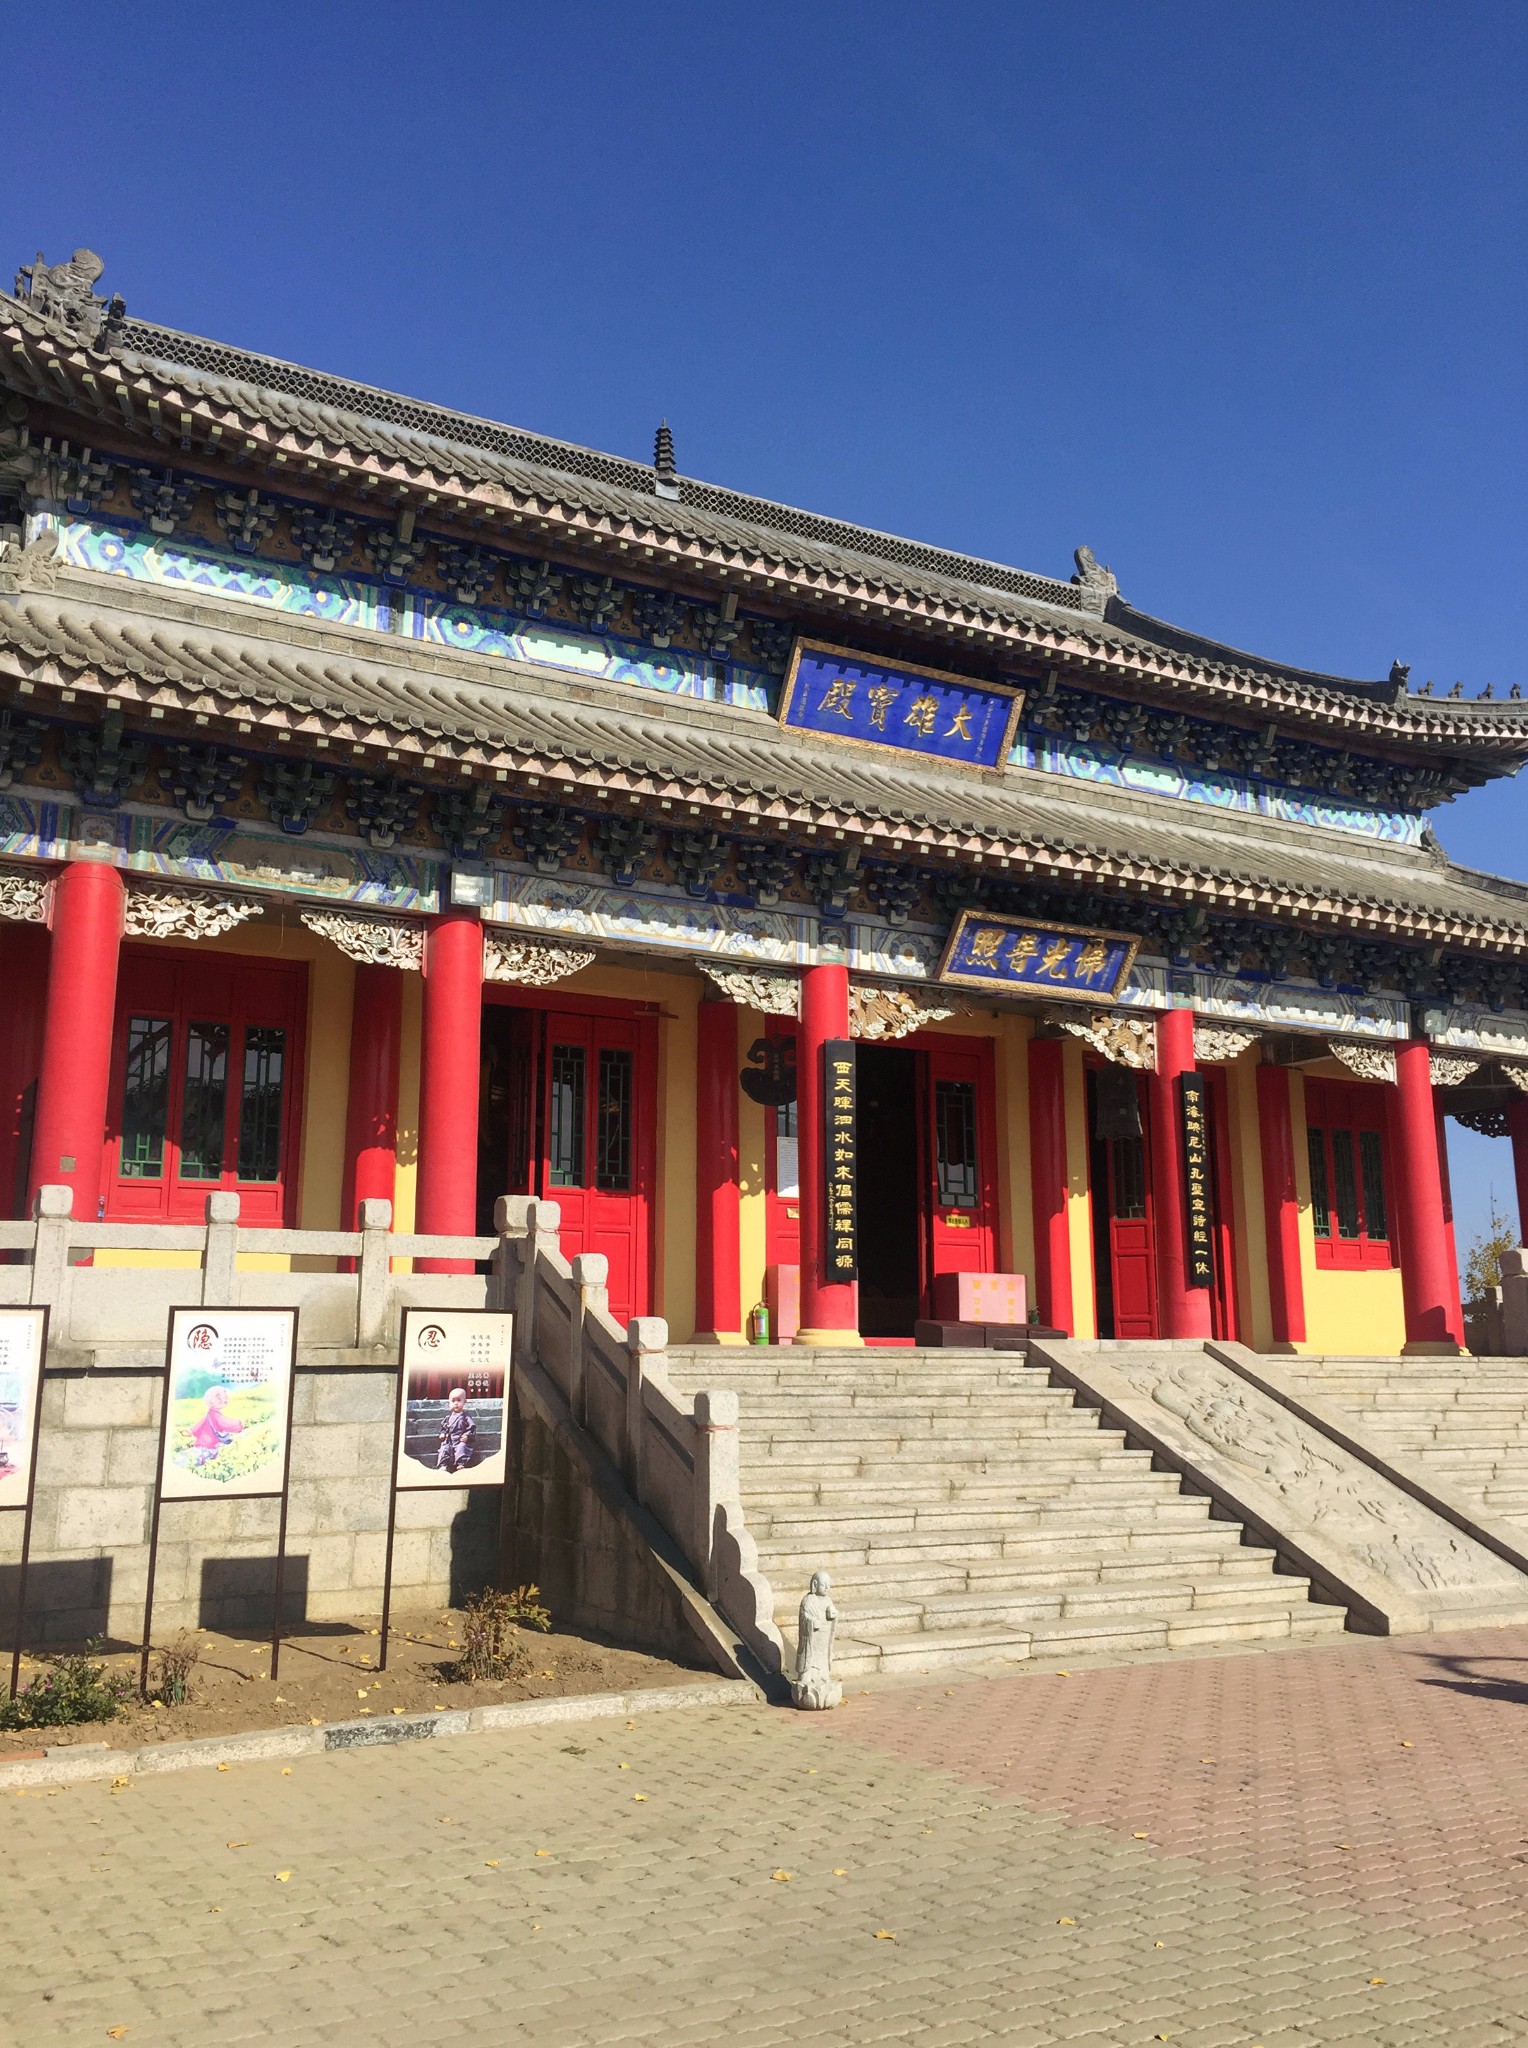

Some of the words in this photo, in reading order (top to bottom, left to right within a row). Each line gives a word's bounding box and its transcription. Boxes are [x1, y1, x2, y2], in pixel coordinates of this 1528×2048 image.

[817, 679, 973, 741] 大雄寶殿
[966, 928, 1108, 985] 佛光普照
[193, 1328, 212, 1350] 隐
[424, 1330, 441, 1348] 忍
